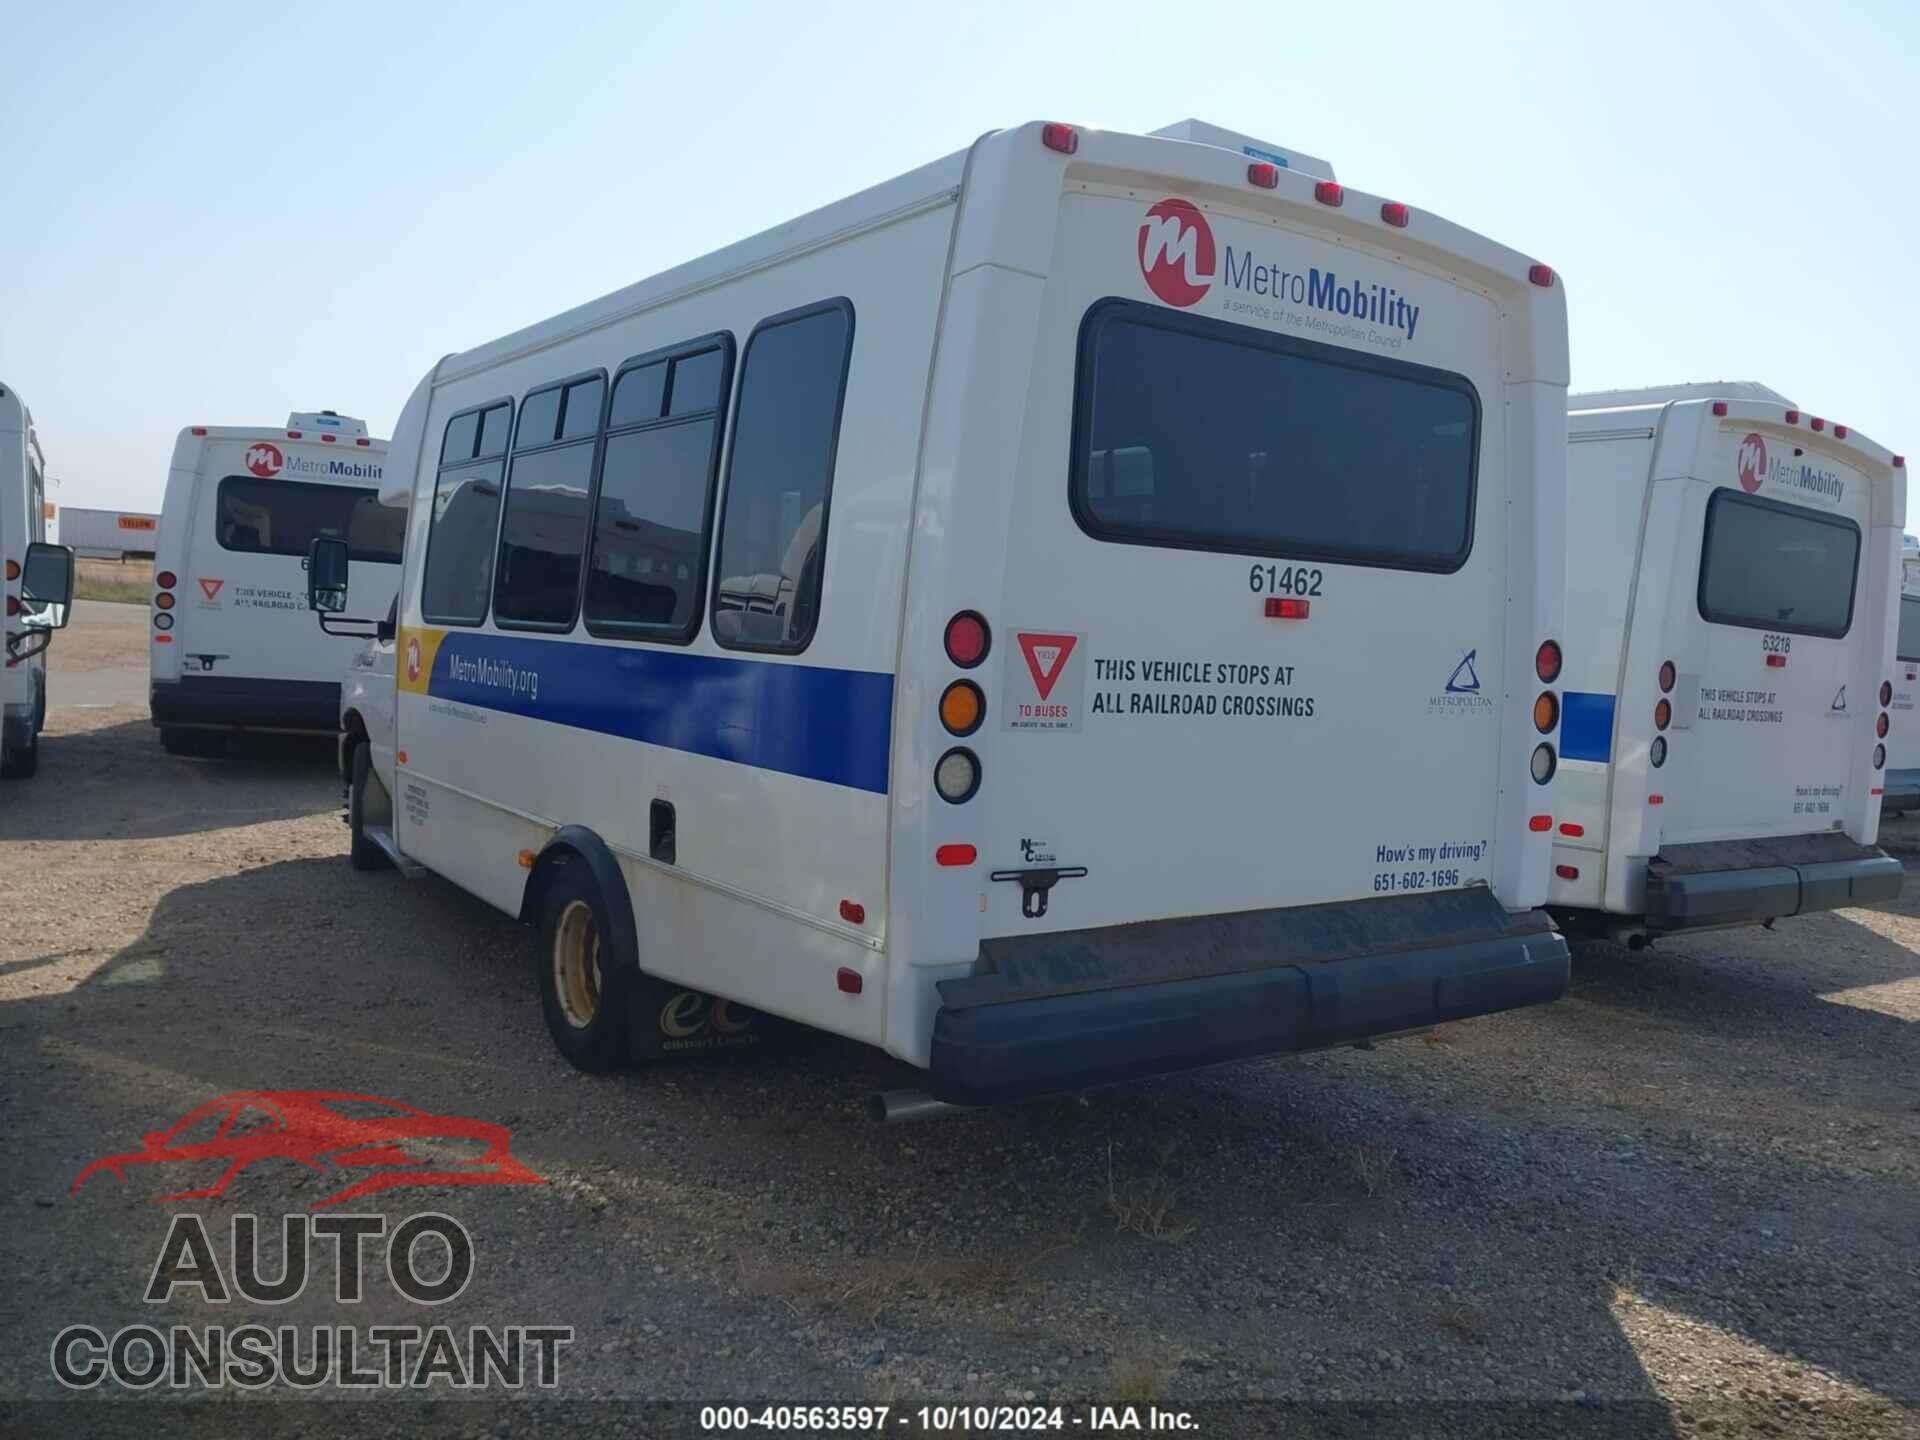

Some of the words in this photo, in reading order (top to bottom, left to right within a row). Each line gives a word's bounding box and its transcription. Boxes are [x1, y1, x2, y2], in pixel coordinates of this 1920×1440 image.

[1224, 246, 1419, 339] MetroMobility
[1273, 310, 1285, 321] of
[1287, 312, 1302, 326] the
[287, 456, 383, 479] MetroMobilit
[1768, 457, 1844, 503] MetroMobility
[1250, 564, 1322, 596] 61462
[1763, 634, 1791, 653] 63218
[451, 653, 538, 700] MetroMobility.org
[1094, 659, 1136, 681] THIS
[1142, 661, 1212, 683] VEHICLE
[1217, 664, 1270, 685] STOPS
[1274, 666, 1294, 686] AT
[1018, 704, 1032, 717] TO
[1035, 704, 1068, 718] BUSES
[1092, 692, 1124, 714] ALL
[1130, 693, 1217, 715] RAILROAD
[1223, 695, 1315, 717] CROSSINGS
[1376, 845, 1415, 863] How's
[1418, 846, 1436, 863] my
[1440, 840, 1487, 861] driving?
[1374, 869, 1458, 891] 651-602-1696
